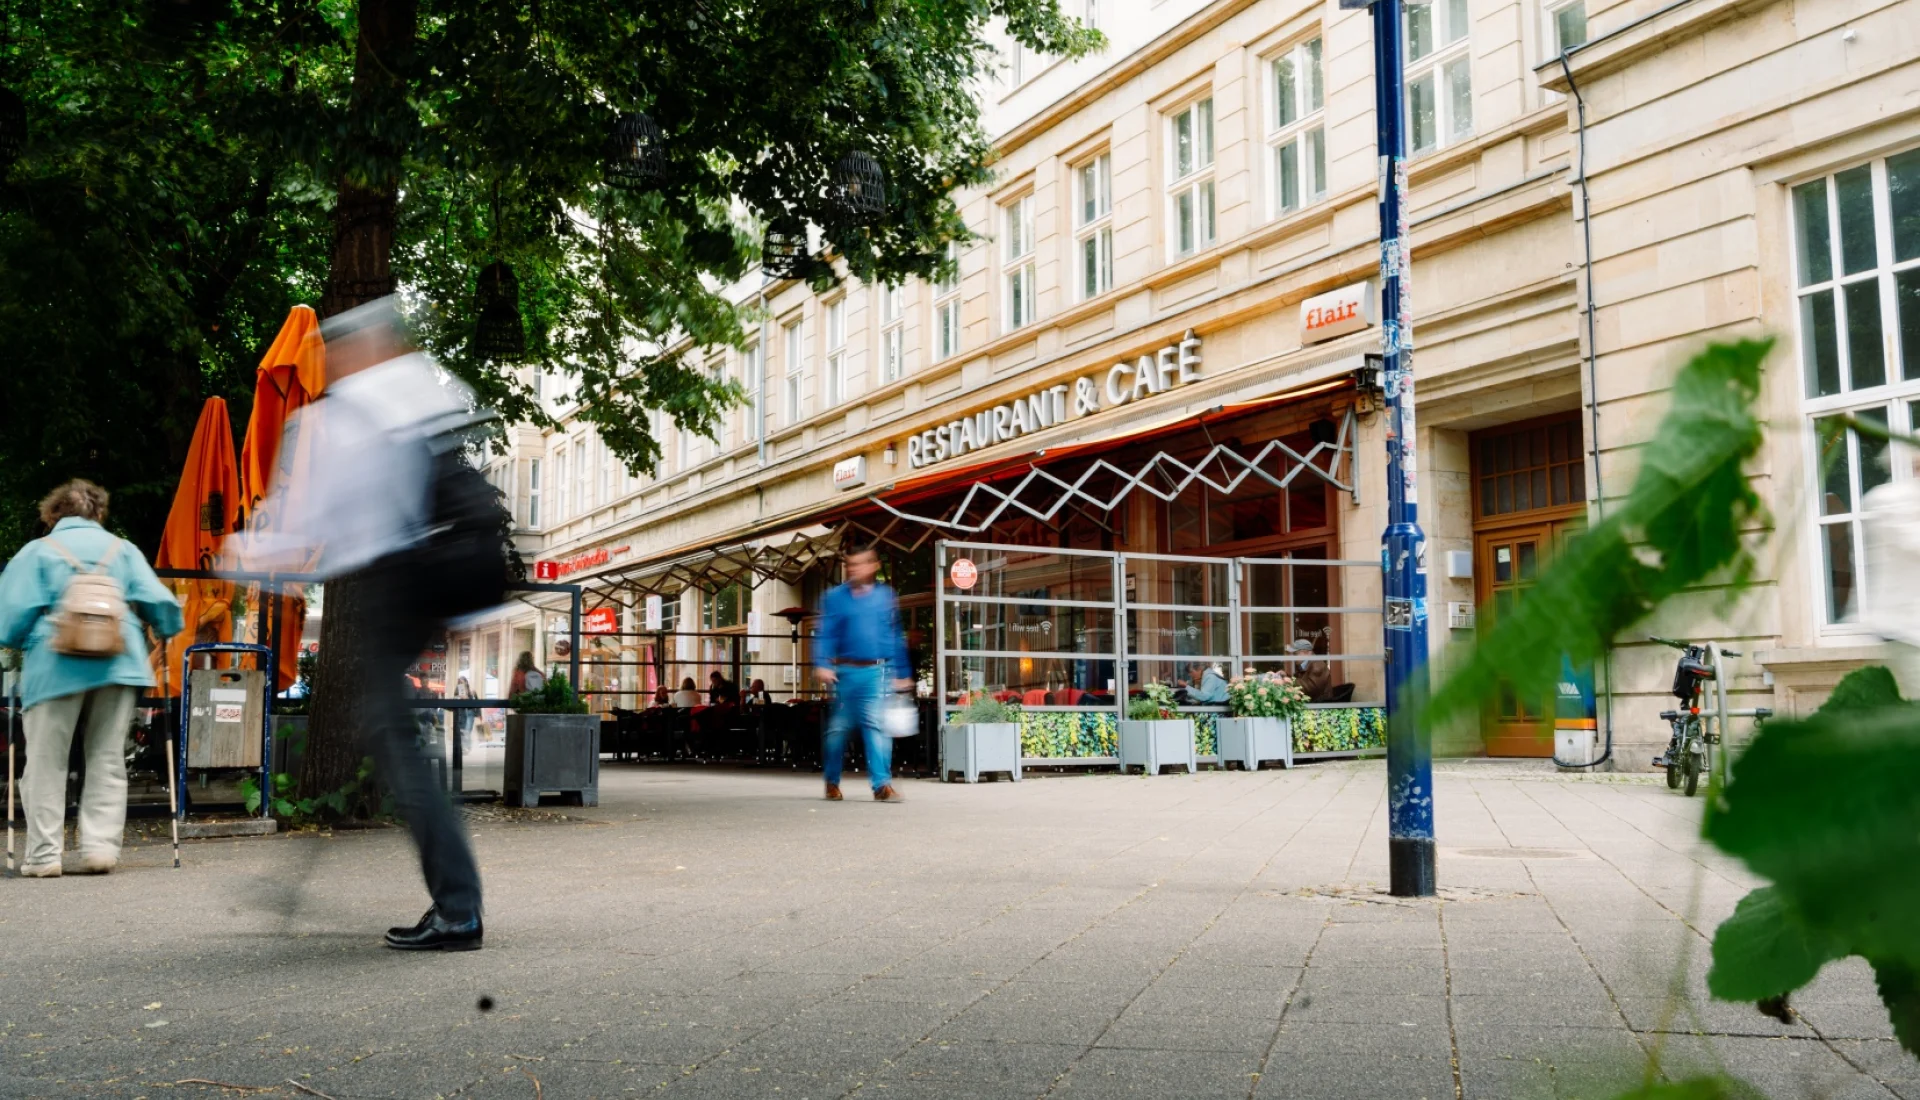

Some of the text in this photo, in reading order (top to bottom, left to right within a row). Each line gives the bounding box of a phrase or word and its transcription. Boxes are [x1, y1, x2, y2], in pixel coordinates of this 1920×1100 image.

[1306, 300, 1358, 331] flair
[908, 328, 1202, 469] RESTAURANT & CAFÉ
[836, 466, 856, 482] flair
